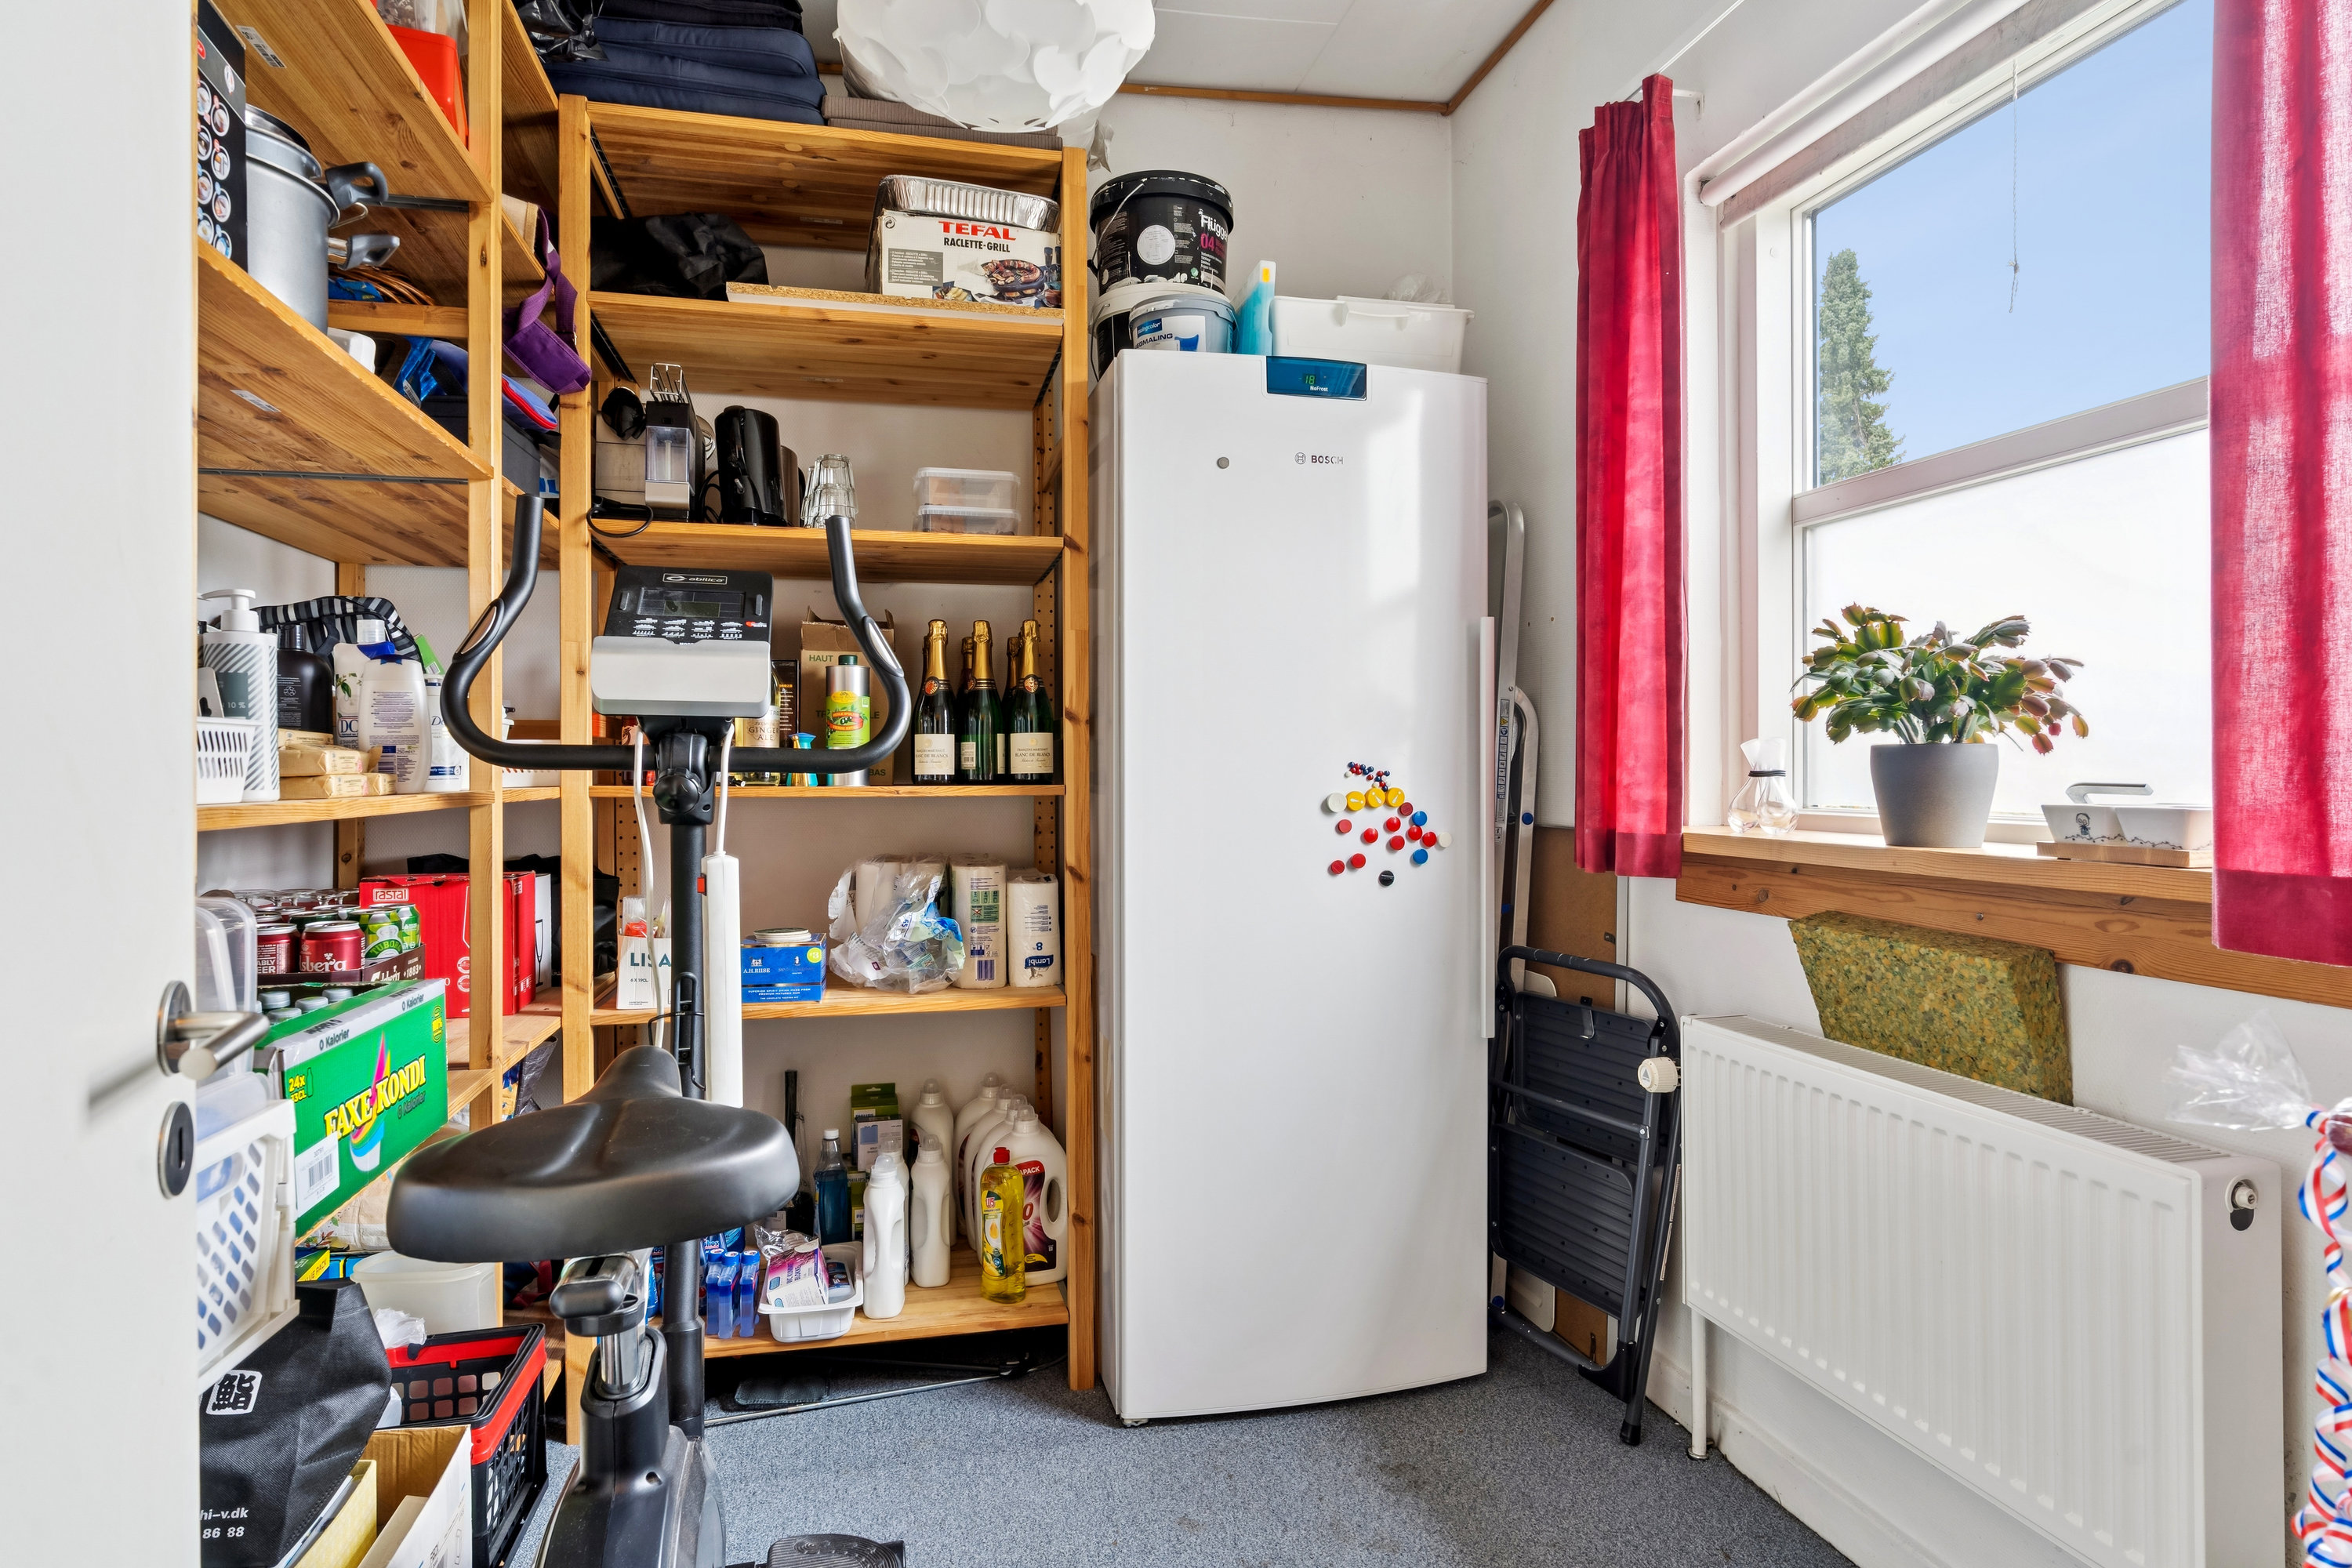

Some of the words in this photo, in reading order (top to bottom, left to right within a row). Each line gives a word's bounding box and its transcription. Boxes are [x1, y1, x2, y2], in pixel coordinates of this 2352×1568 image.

[938, 220, 1016, 241] TEFAL
[944, 238, 1010, 252] RACLETTE-GRILL
[1200, 233, 1214, 251] 04
[1311, 455, 1344, 465] BOSCH
[1036, 942, 1044, 950] 8
[406, 993, 424, 1008] Kalorier
[325, 1029, 350, 1048] Kalorier
[324, 1087, 373, 1141] FAXE
[375, 1054, 426, 1115] KONDI
[200, 1507, 249, 1521] hi-v.dk
[202, 1527, 221, 1539] 86
[227, 1526, 245, 1537] 88
